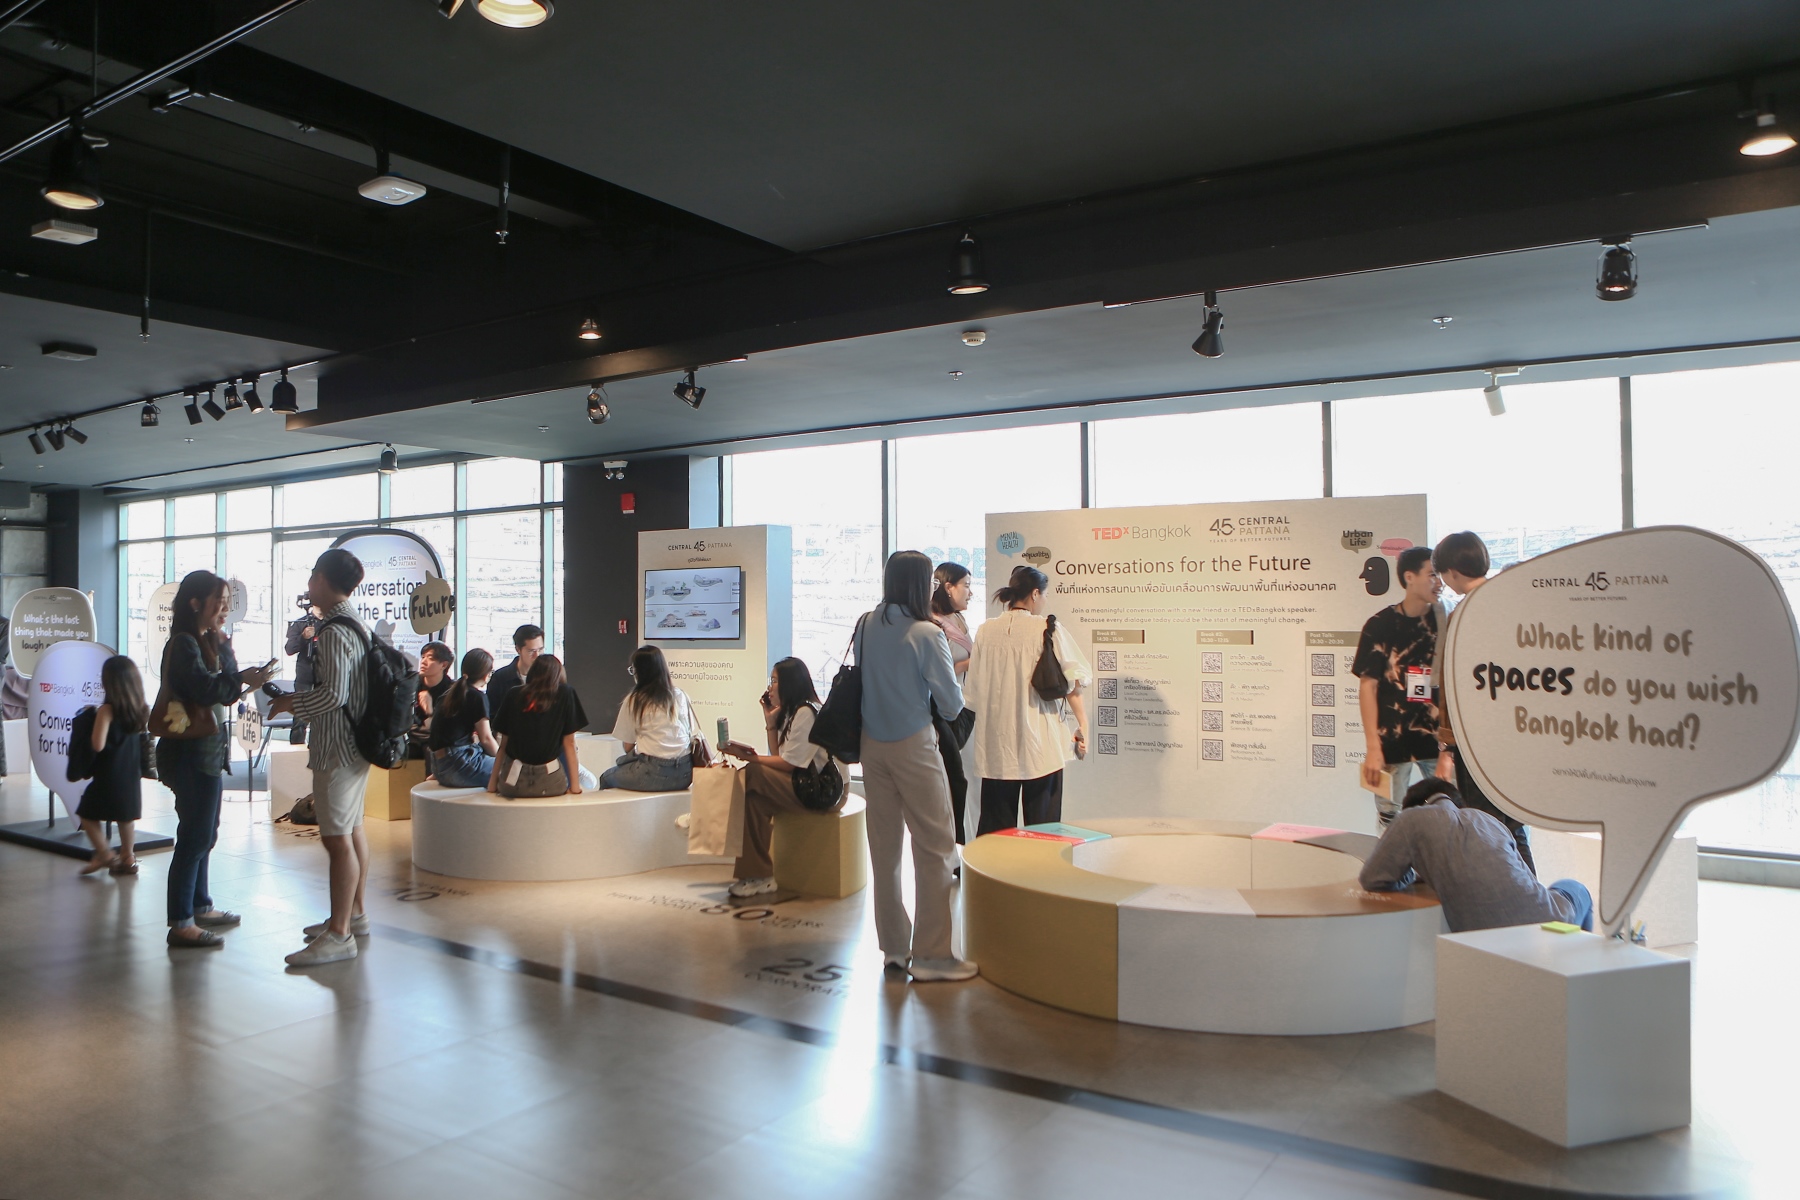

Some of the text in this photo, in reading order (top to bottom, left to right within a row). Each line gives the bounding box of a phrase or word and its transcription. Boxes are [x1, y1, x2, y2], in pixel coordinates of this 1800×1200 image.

[1209, 518, 1235, 536] 45
[1239, 516, 1290, 525] CENTRAL
[1000, 531, 1018, 540] MENTAL
[1239, 526, 1290, 535] PATTANA
[1342, 529, 1373, 538] Urban
[693, 541, 706, 552] 45
[1002, 538, 1019, 549] HEALTH
[1349, 538, 1367, 546] Life
[1055, 554, 1311, 576] Conversations for the Future
[1532, 572, 1669, 591] CENTRAL 45 PATTANA
[411, 595, 456, 620] Future
[1287, 606, 1317, 614] speaker.
[23, 611, 79, 625] What's the last
[1239, 616, 1277, 624] meaningful
[1278, 616, 1306, 624] change.
[14, 626, 89, 639] thing that made you
[1516, 622, 1693, 657] What kind of
[22, 640, 43, 653] laugh
[81, 682, 93, 697] 45
[1473, 661, 1758, 706] spaces do you wish
[243, 723, 256, 743] Life
[1514, 705, 1700, 751] Bangkok had?
[39, 734, 53, 753] for
[760, 958, 852, 982] 25
